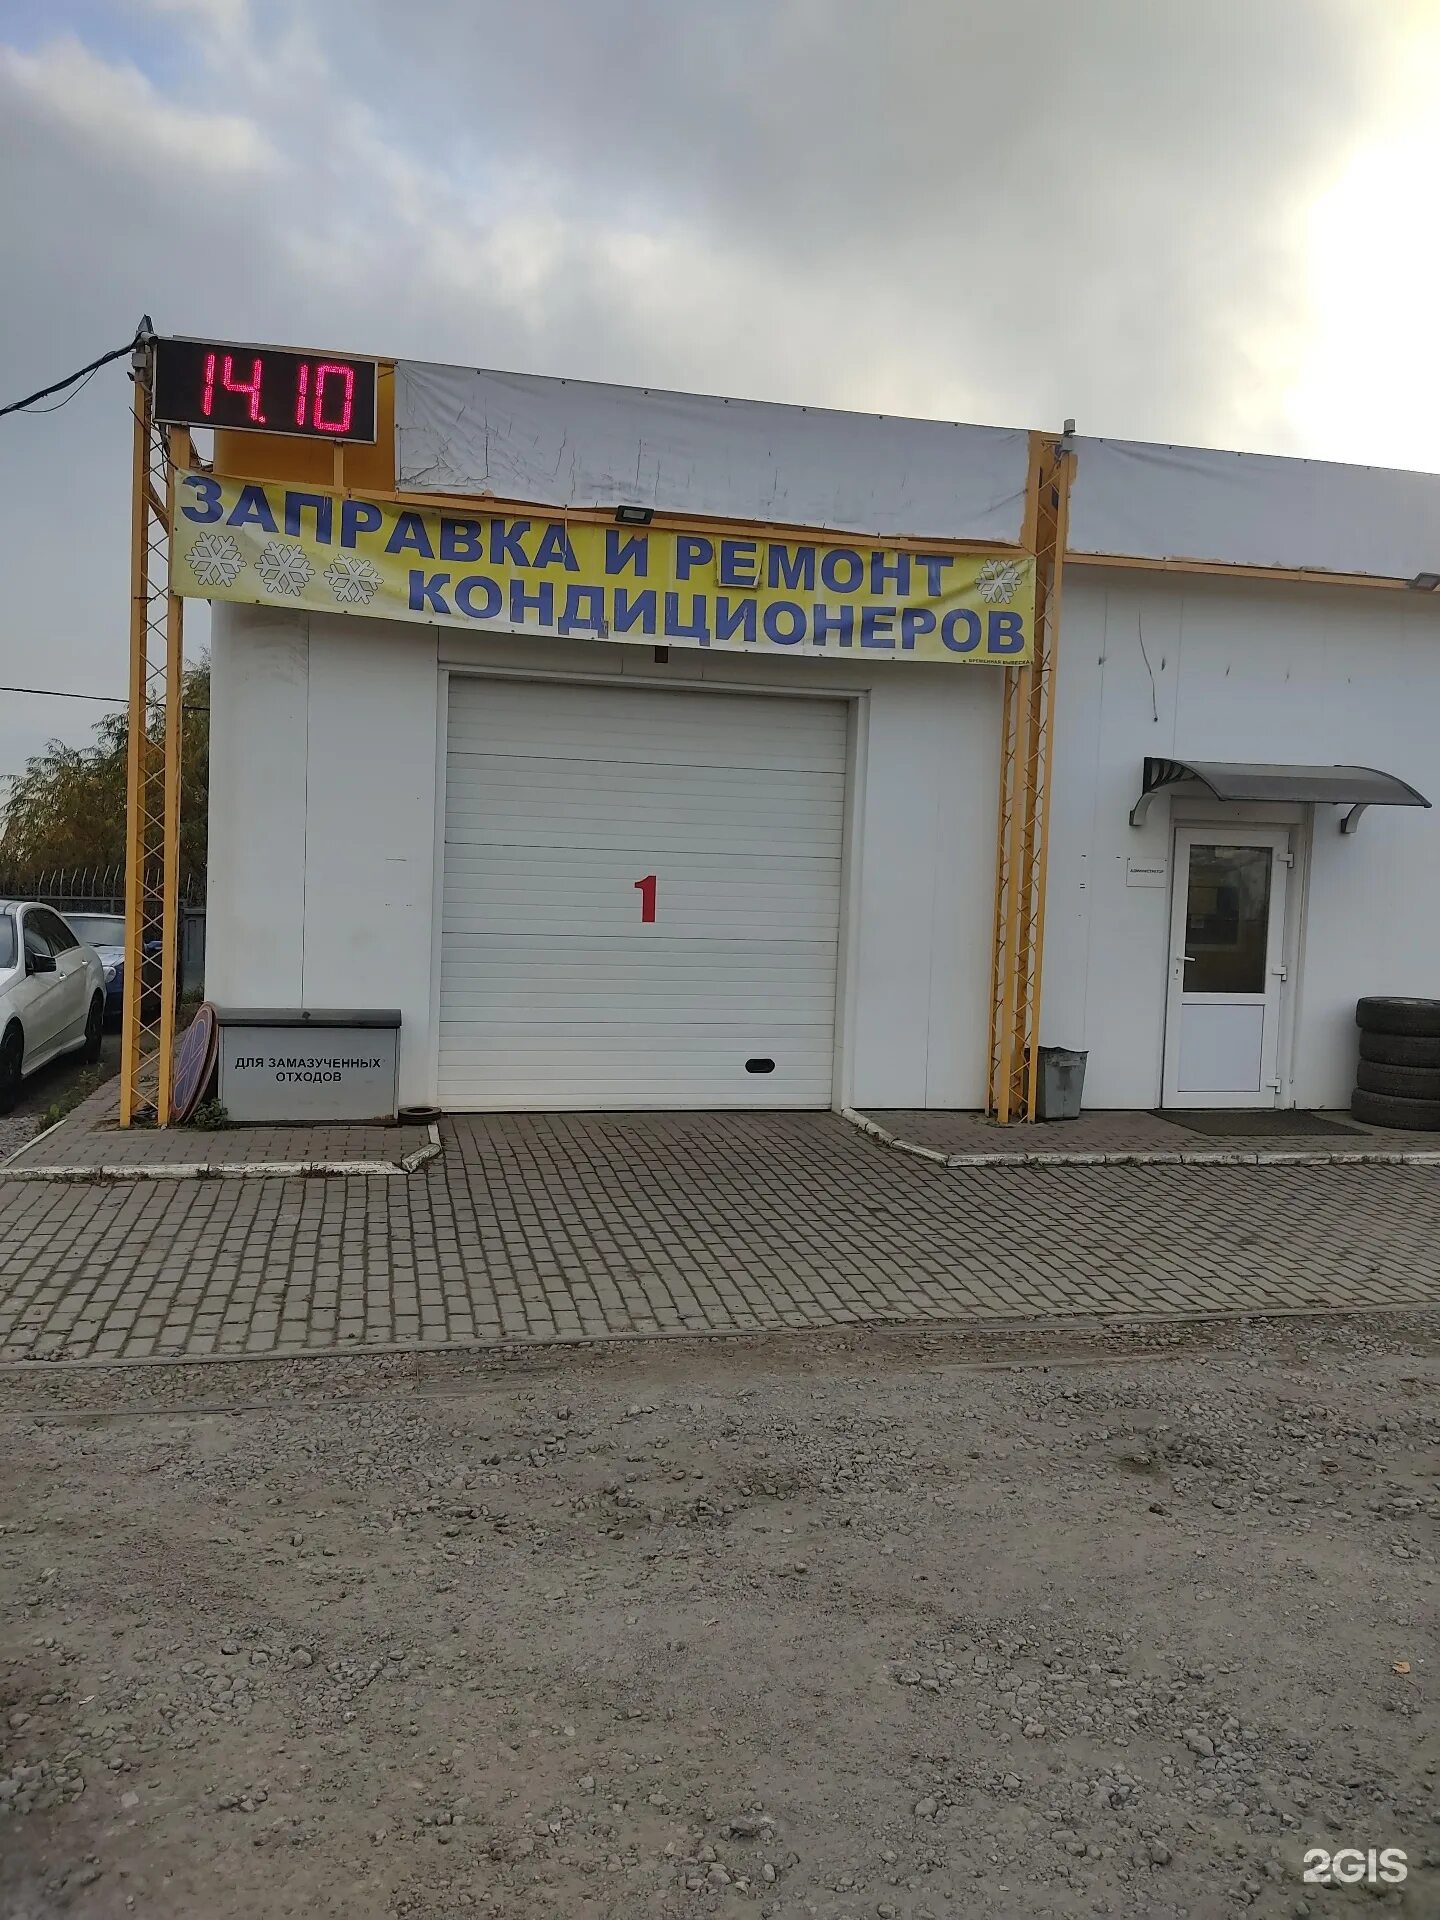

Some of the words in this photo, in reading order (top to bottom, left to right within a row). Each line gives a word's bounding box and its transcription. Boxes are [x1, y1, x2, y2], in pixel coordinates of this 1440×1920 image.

[180, 475, 580, 572] ЗАПРАВКА
[605, 529, 649, 577] И
[675, 535, 954, 597] РЕМОНТ
[408, 570, 1026, 655] КОНДИЦИОНЕРОВ
[634, 875, 657, 923] 1
[235, 1058, 264, 1070] ДЛЯ
[268, 1058, 381, 1069] ЗАМАЗУЧЕННЫХ
[275, 1071, 342, 1083] ОТХОДОВ
